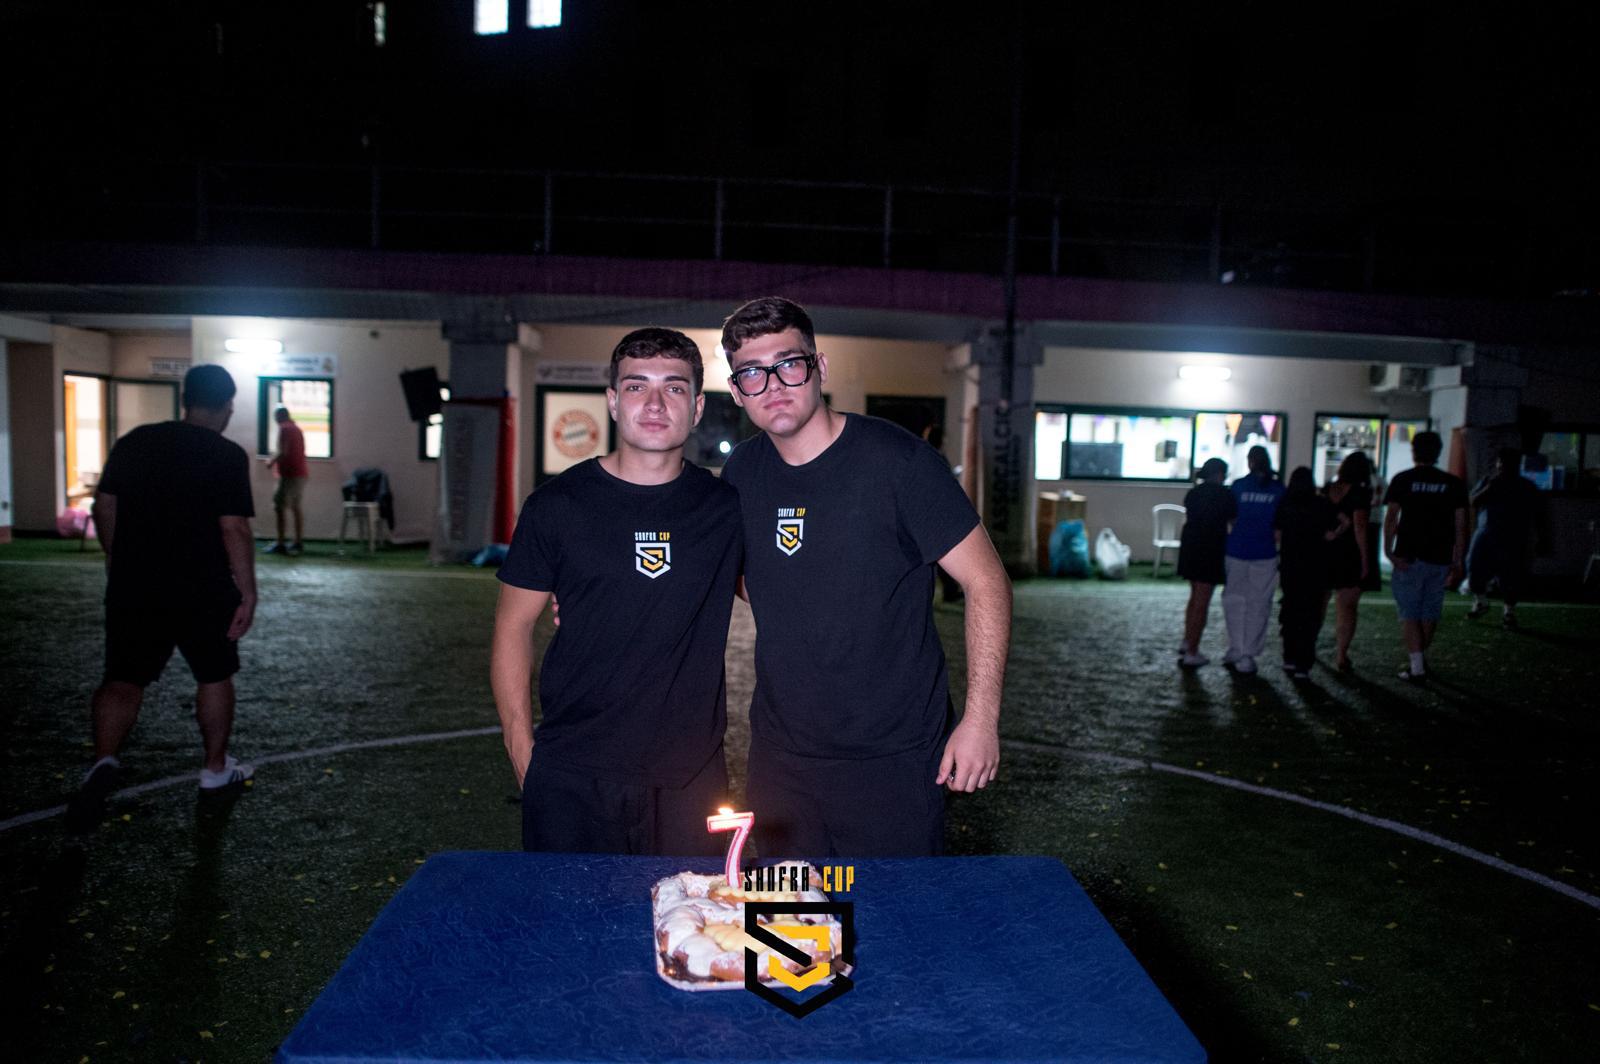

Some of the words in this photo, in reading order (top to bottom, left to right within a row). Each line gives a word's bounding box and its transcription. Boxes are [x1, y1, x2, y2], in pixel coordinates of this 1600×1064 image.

[1411, 481, 1447, 494] STAFF
[1239, 491, 1275, 504] STAFF
[796, 507, 806, 517] CUP
[659, 531, 670, 541] CUP
[707, 811, 754, 888] 7
